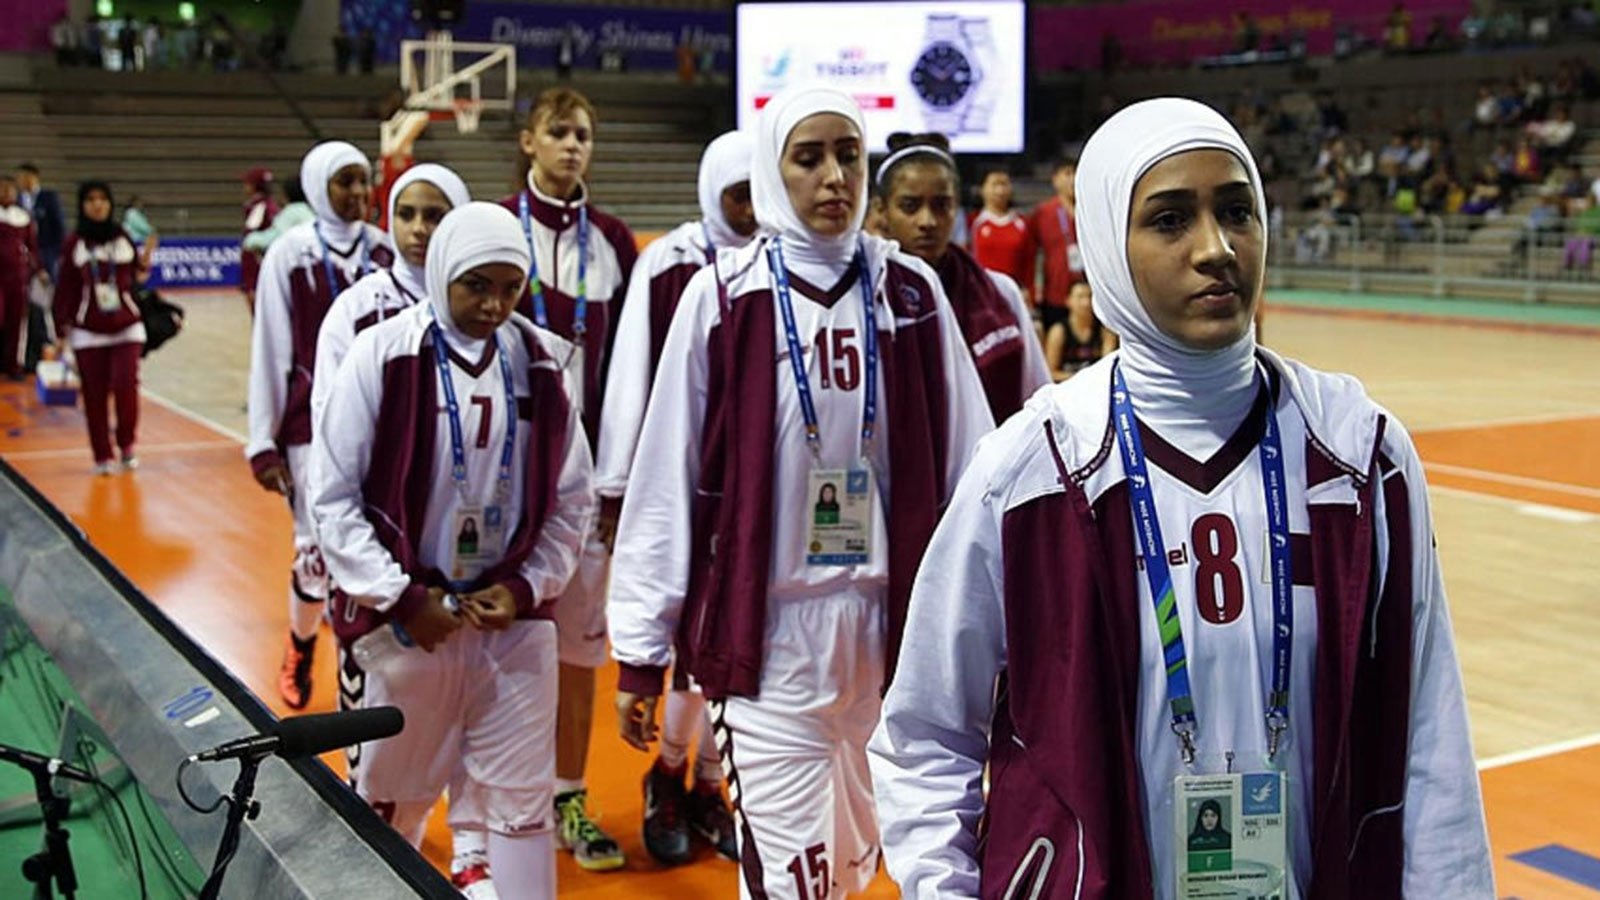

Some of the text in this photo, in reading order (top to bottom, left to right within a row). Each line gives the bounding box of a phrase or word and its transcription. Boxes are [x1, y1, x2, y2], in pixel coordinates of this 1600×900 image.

[814, 327, 860, 391] 15
[470, 395, 492, 449] 7
[1192, 512, 1245, 625] 8
[787, 843, 829, 900] 15
